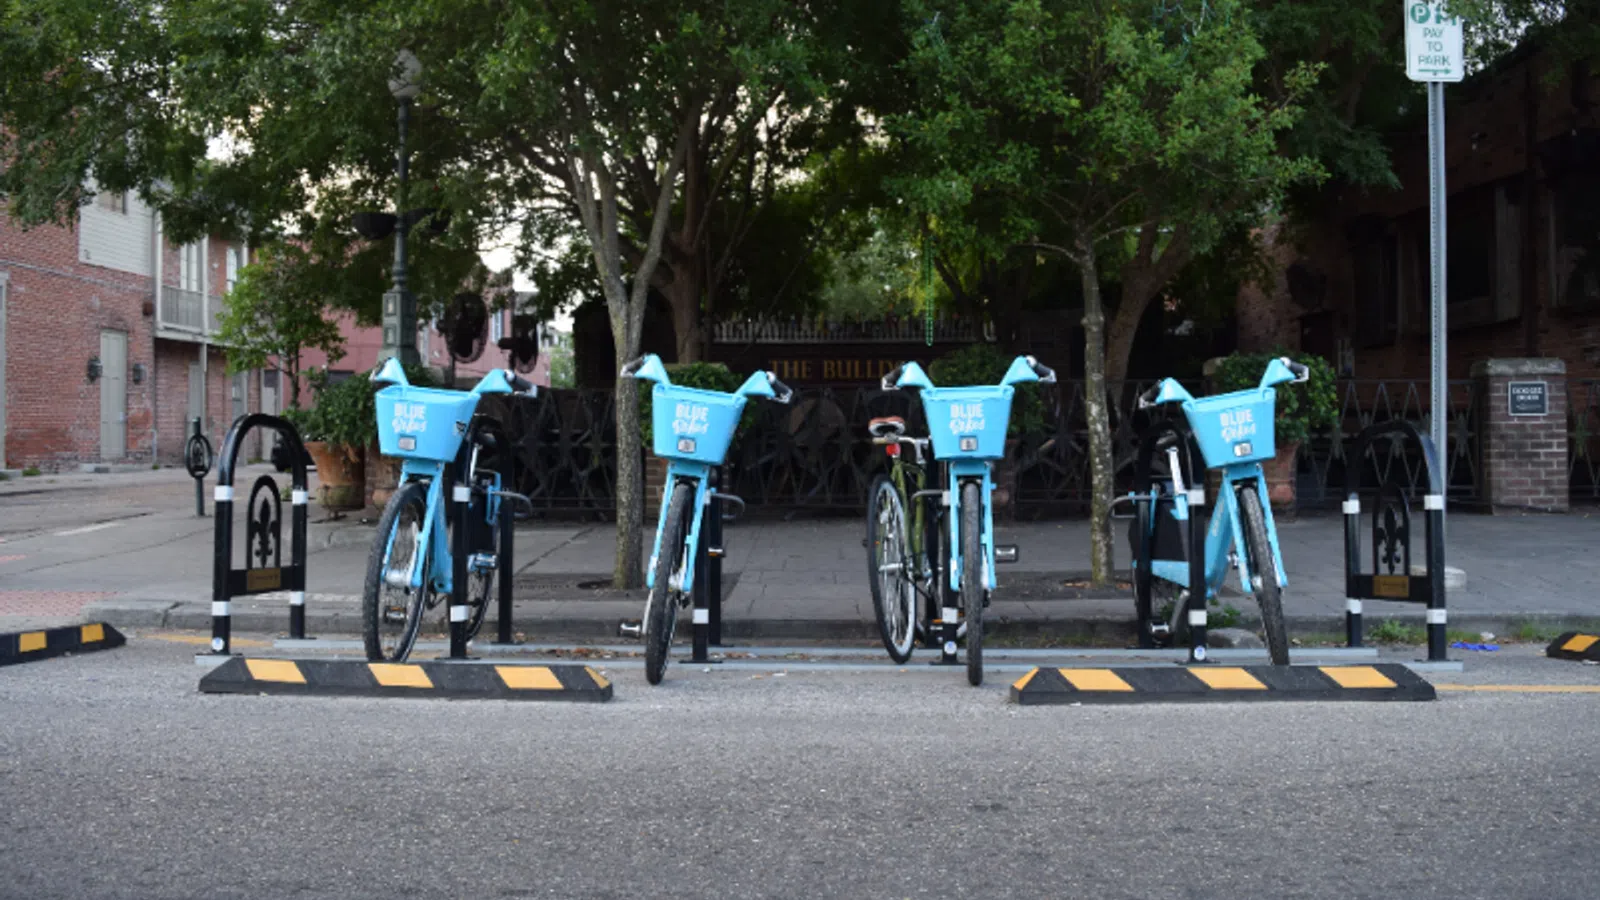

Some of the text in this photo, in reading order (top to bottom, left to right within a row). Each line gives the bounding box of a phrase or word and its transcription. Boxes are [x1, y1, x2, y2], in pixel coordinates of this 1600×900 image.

[1423, 27, 1444, 38] PAY
[1427, 41, 1443, 52] TO
[1418, 55, 1451, 66] PARK
[769, 358, 906, 380] THE BULLD
[393, 402, 426, 419] BLUE
[675, 402, 709, 421] BLUE
[949, 403, 985, 419] BLUE
[1219, 408, 1254, 427] BLUE
